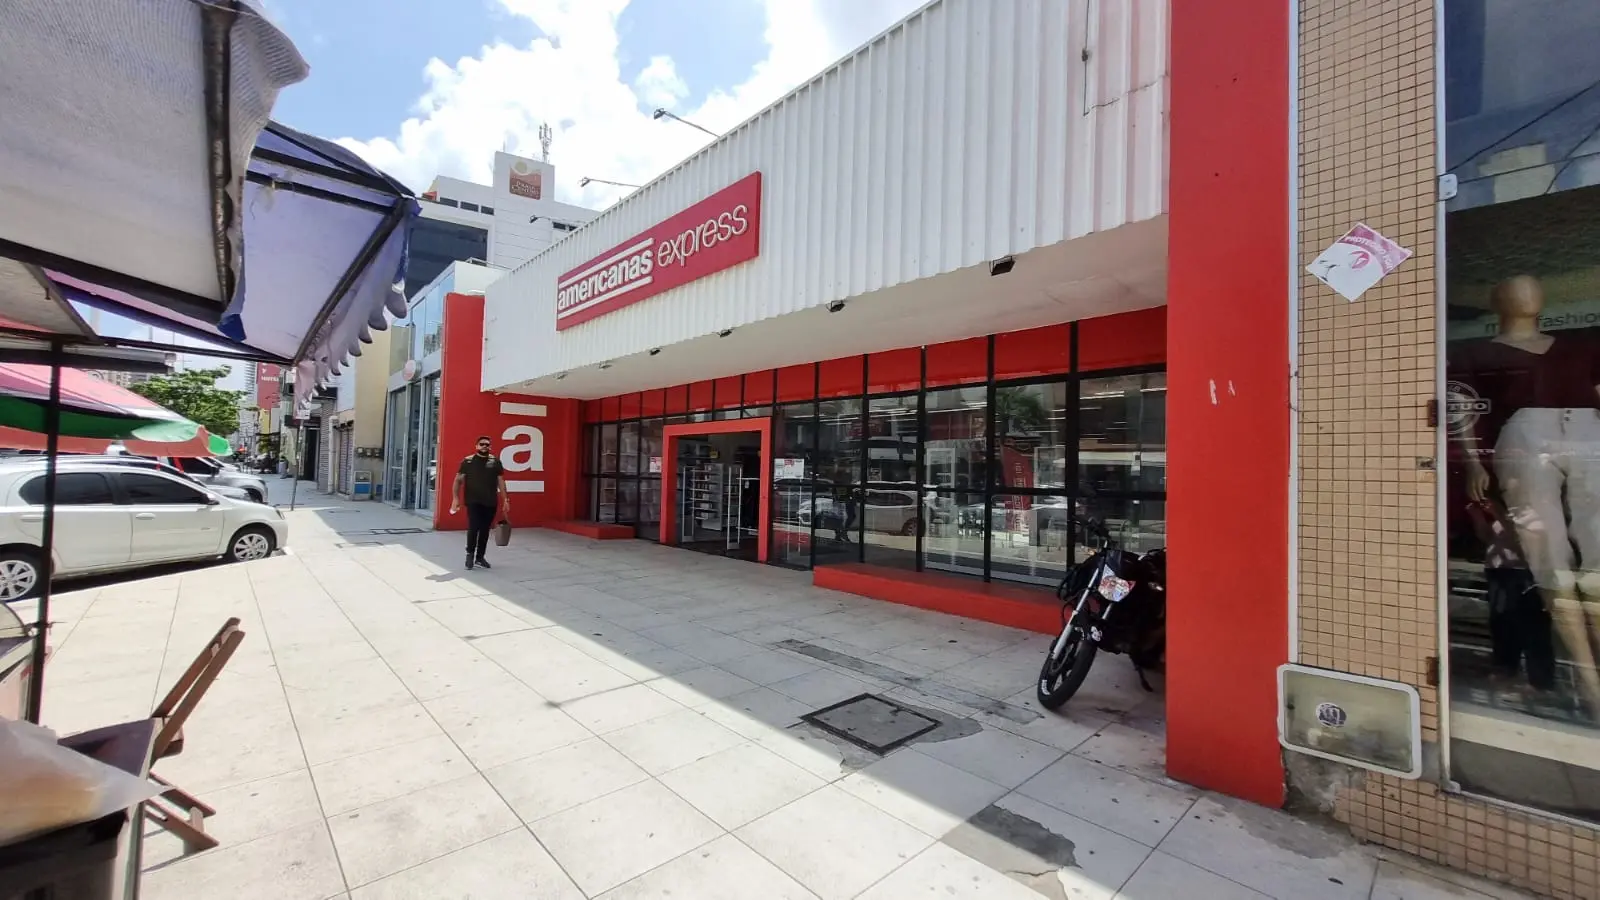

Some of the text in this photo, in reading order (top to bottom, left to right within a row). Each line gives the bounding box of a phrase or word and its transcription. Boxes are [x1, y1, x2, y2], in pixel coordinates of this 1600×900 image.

[558, 204, 748, 310] americanas express
[499, 425, 544, 471] a
